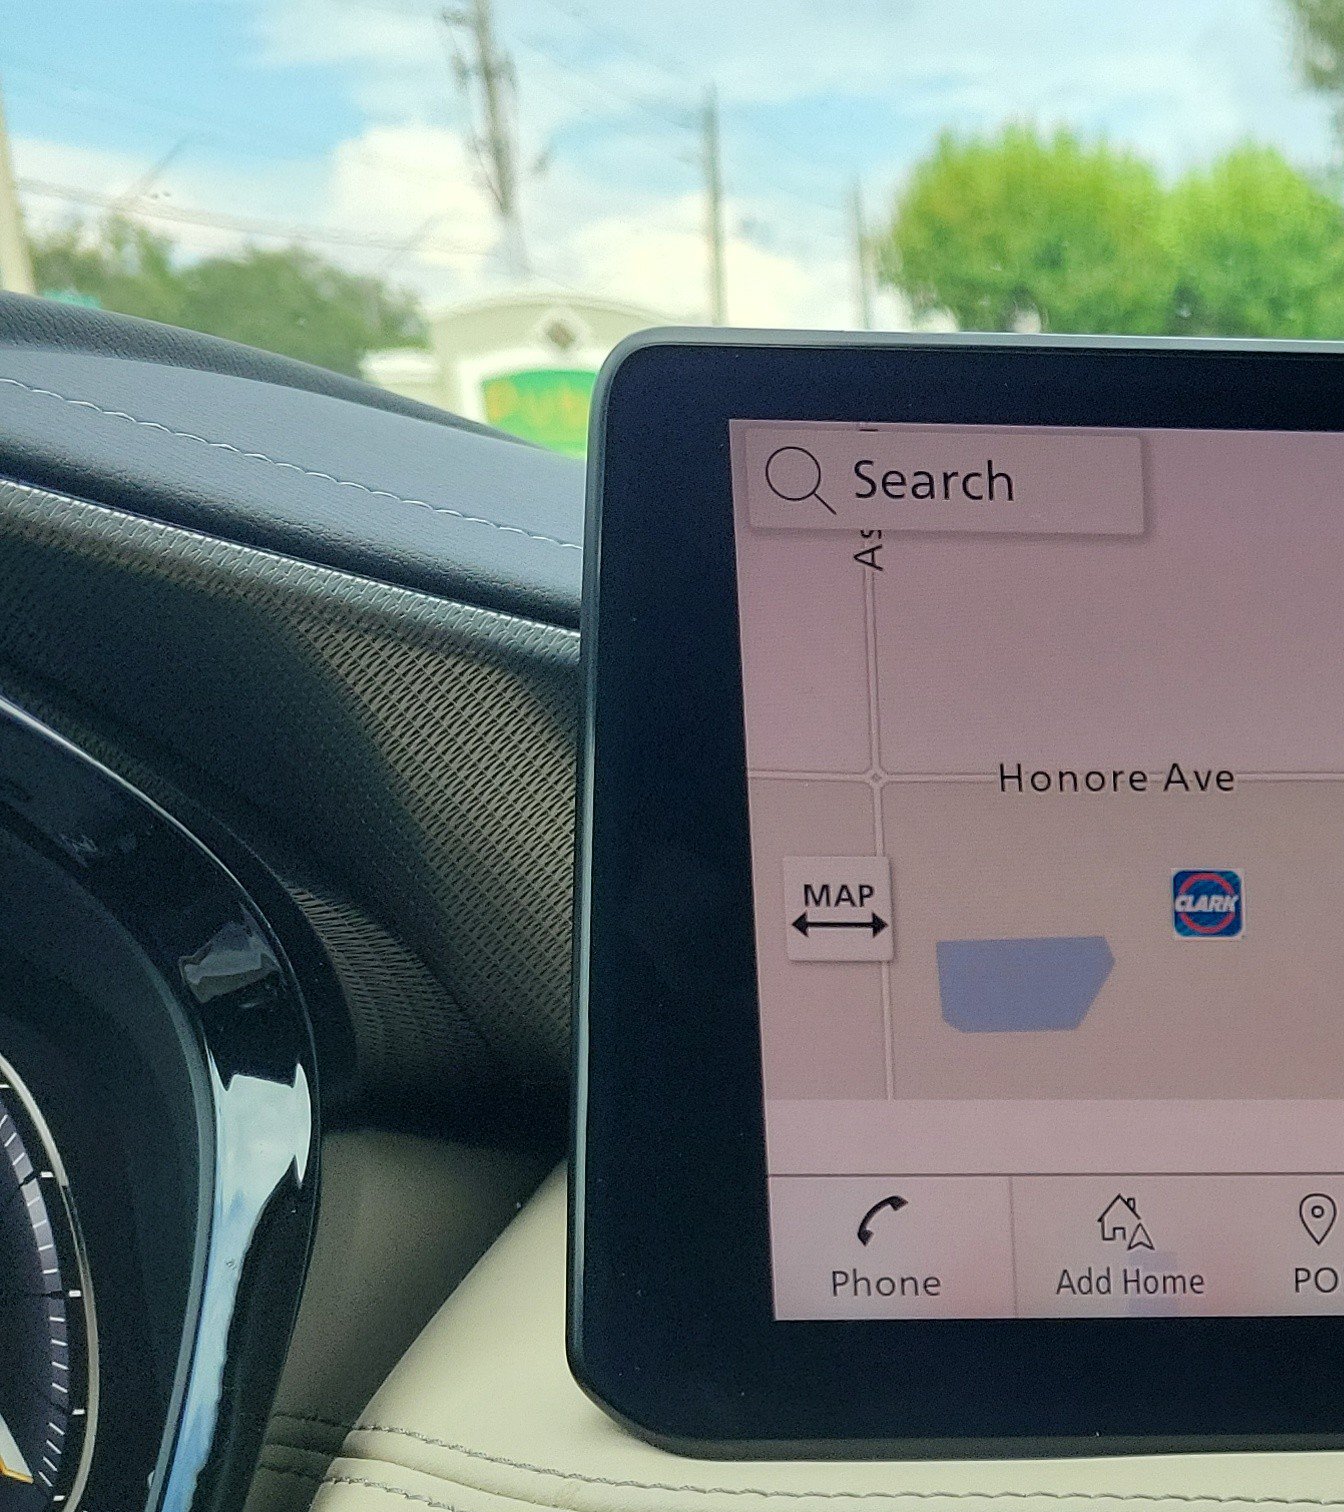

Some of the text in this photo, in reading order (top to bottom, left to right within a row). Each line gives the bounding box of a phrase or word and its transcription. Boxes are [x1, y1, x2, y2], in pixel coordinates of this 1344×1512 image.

[853, 459, 1014, 502] Search
[998, 761, 1236, 794] Honore Ave
[802, 882, 876, 909] MAP
[1174, 894, 1240, 913] CLARK
[831, 1267, 942, 1297] Phone
[1055, 1266, 1206, 1296] Add Home
